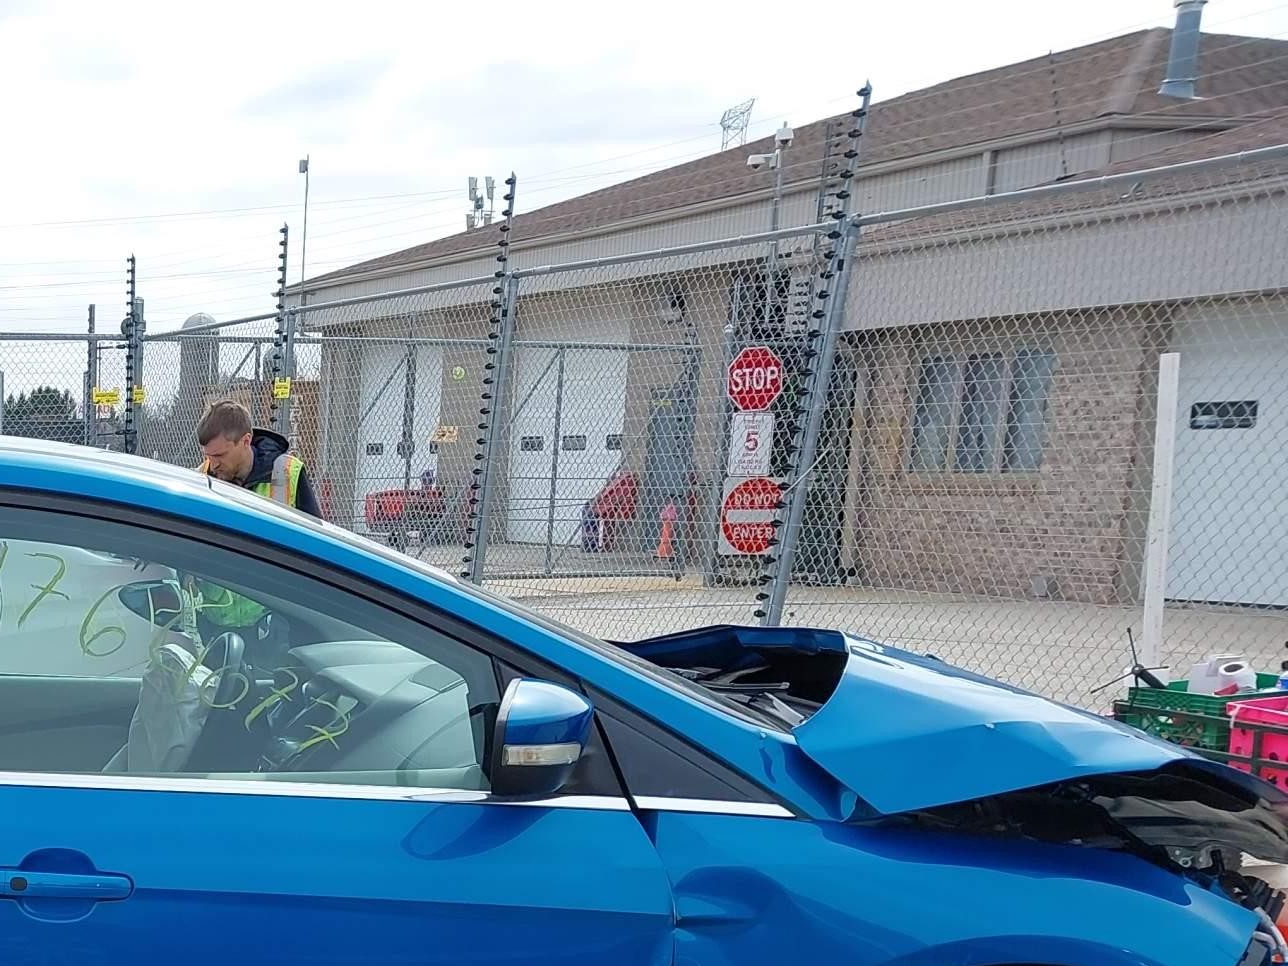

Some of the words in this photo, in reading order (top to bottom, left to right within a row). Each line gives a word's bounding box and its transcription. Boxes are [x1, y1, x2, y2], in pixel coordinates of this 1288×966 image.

[732, 366, 779, 392] STOP
[745, 432, 759, 451] 5
[735, 494, 750, 505] DO
[755, 494, 779, 505] NOT
[733, 527, 773, 540] ENTER
